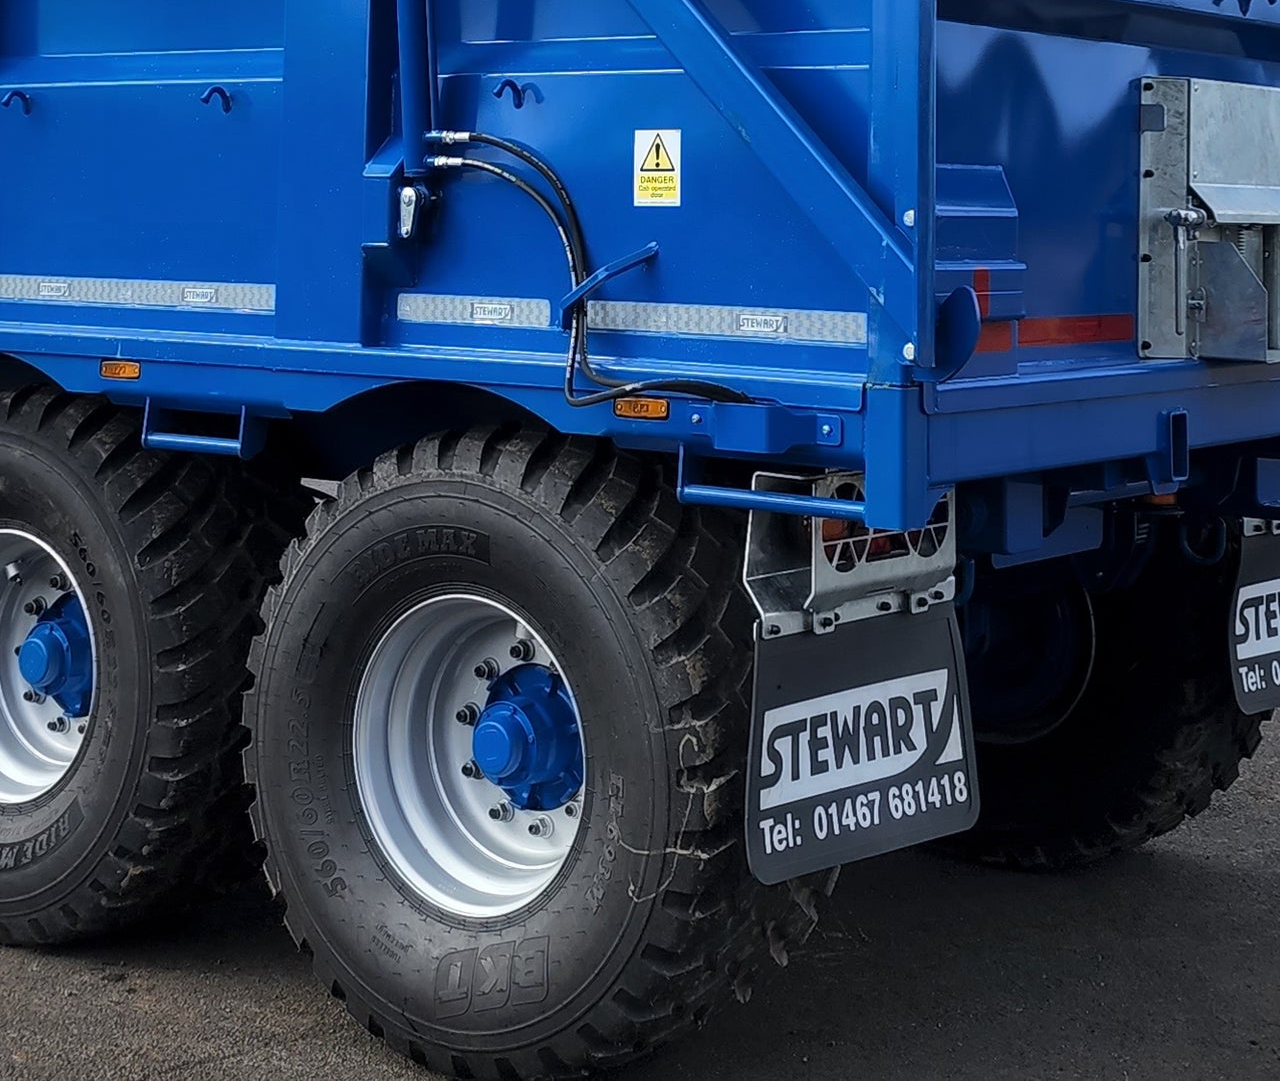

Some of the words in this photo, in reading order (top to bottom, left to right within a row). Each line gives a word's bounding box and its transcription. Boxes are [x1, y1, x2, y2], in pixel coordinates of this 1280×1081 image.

[640, 175, 675, 184] DANGER
[473, 305, 511, 318] STEWART
[739, 315, 786, 332] STEWART
[1239, 664, 1266, 693] Tel:
[760, 685, 956, 790] STEWART
[759, 813, 802, 854] Tel:
[813, 791, 881, 840] 01467
[888, 771, 968, 820] 681418
